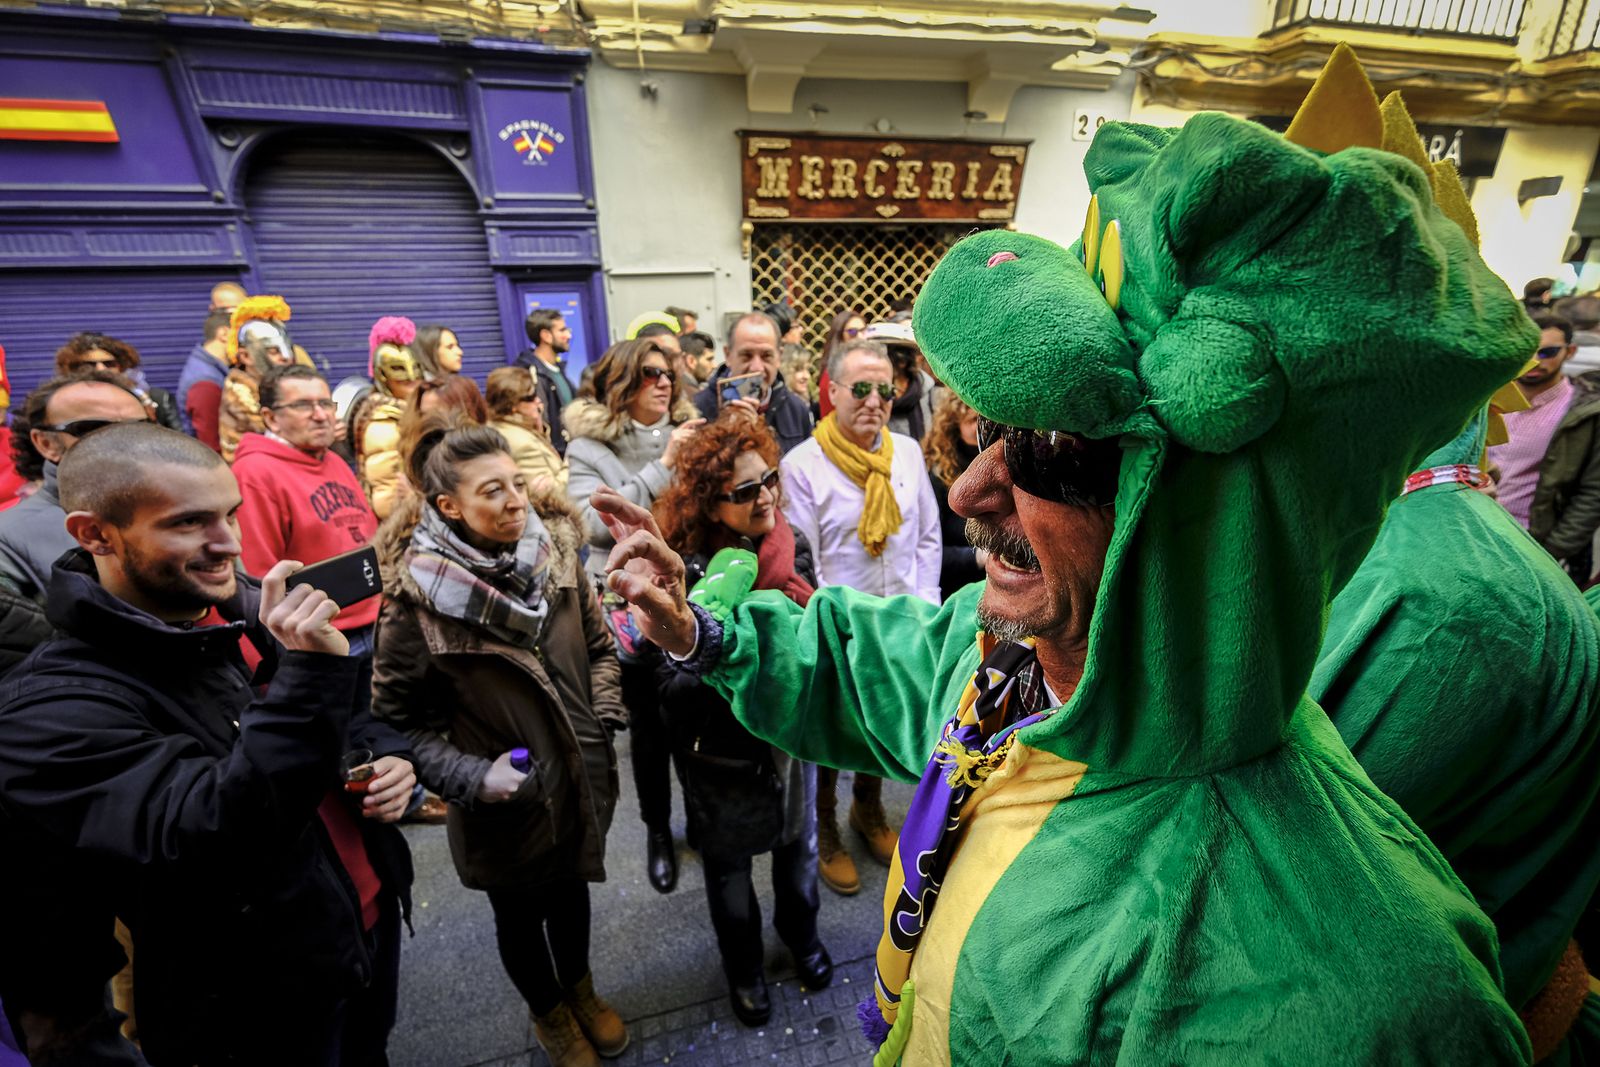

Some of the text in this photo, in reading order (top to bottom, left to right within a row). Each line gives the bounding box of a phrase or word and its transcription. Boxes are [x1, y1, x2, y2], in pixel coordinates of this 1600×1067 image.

[498, 119, 565, 143] SPAGNOLO
[1420, 129, 1464, 168] RÁ
[756, 154, 1015, 201] MERCERIA
